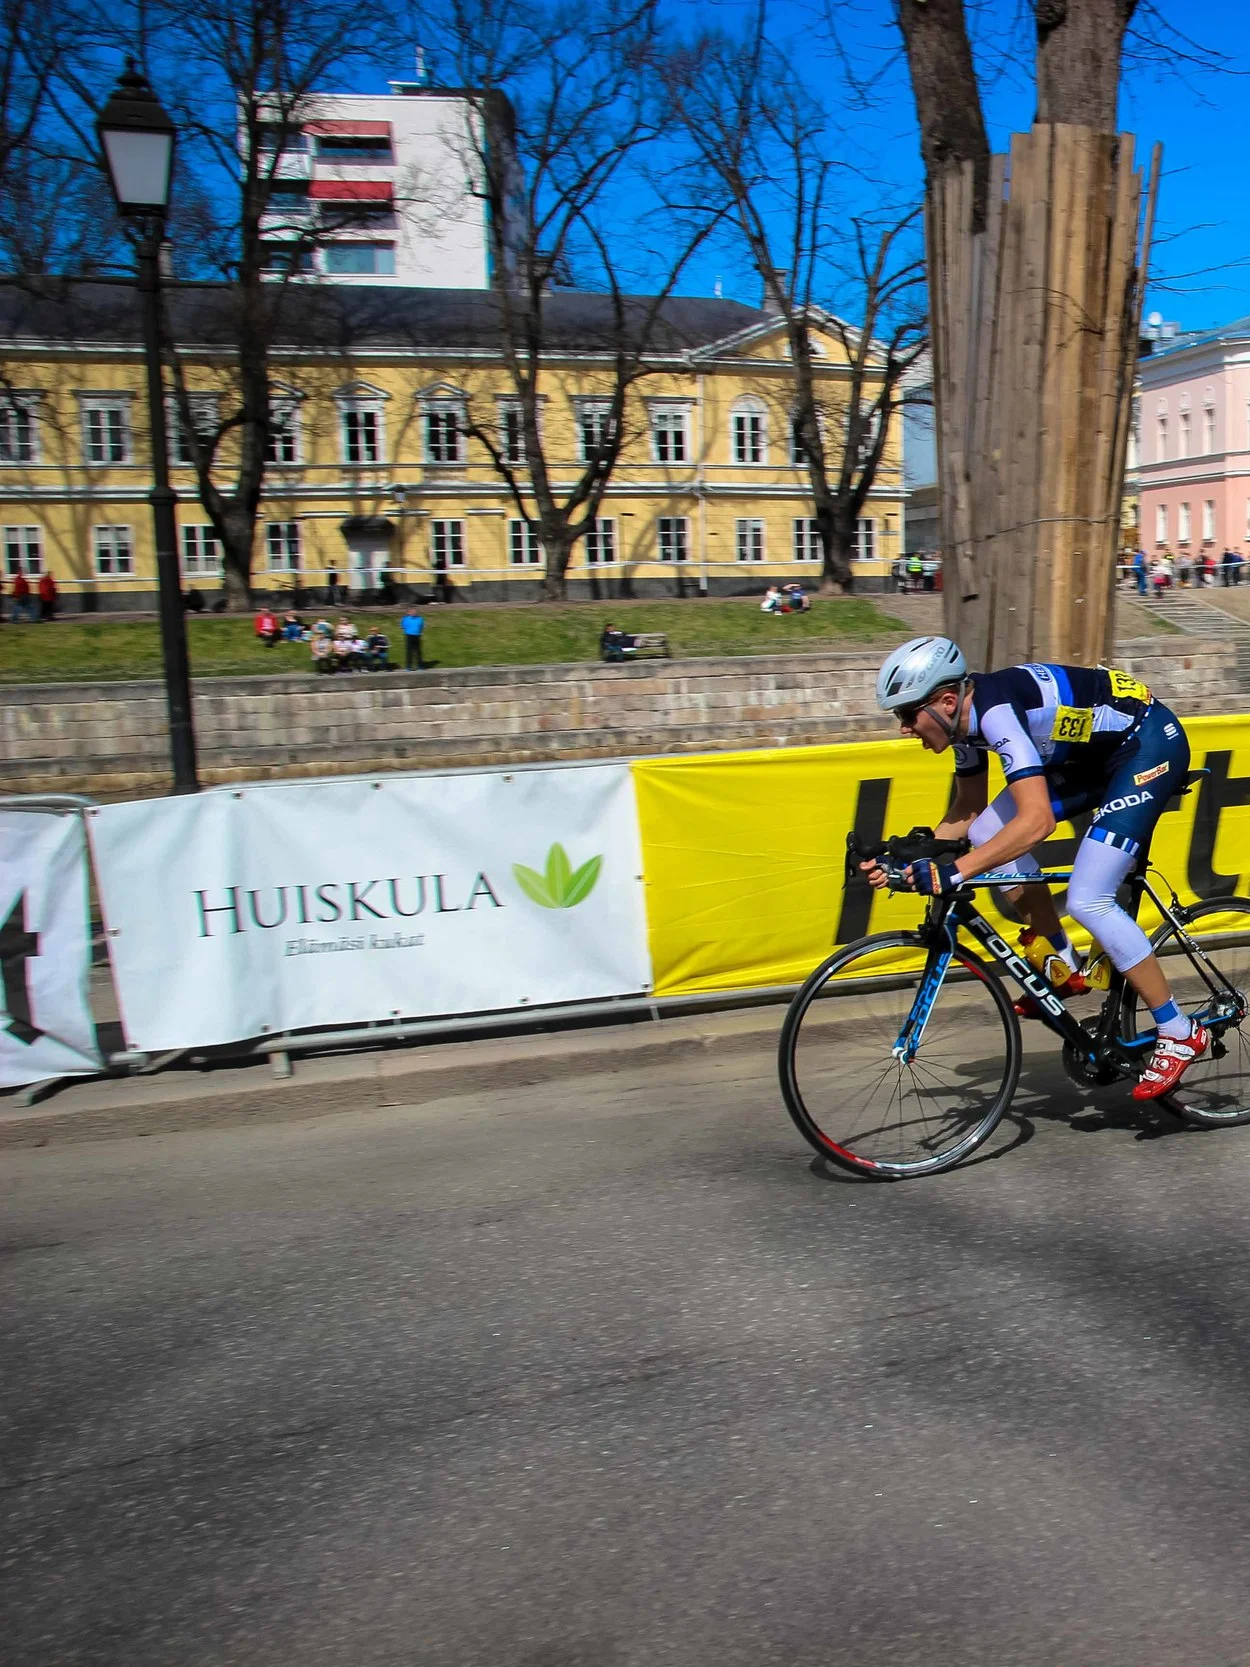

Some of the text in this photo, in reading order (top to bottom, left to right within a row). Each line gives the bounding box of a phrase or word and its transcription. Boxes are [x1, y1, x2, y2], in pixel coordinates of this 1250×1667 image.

[1059, 716, 1086, 738] 133
[1136, 764, 1168, 784] PowerBar
[190, 871, 506, 938] HUISKULA
[967, 914, 1066, 1017] FOCUS
